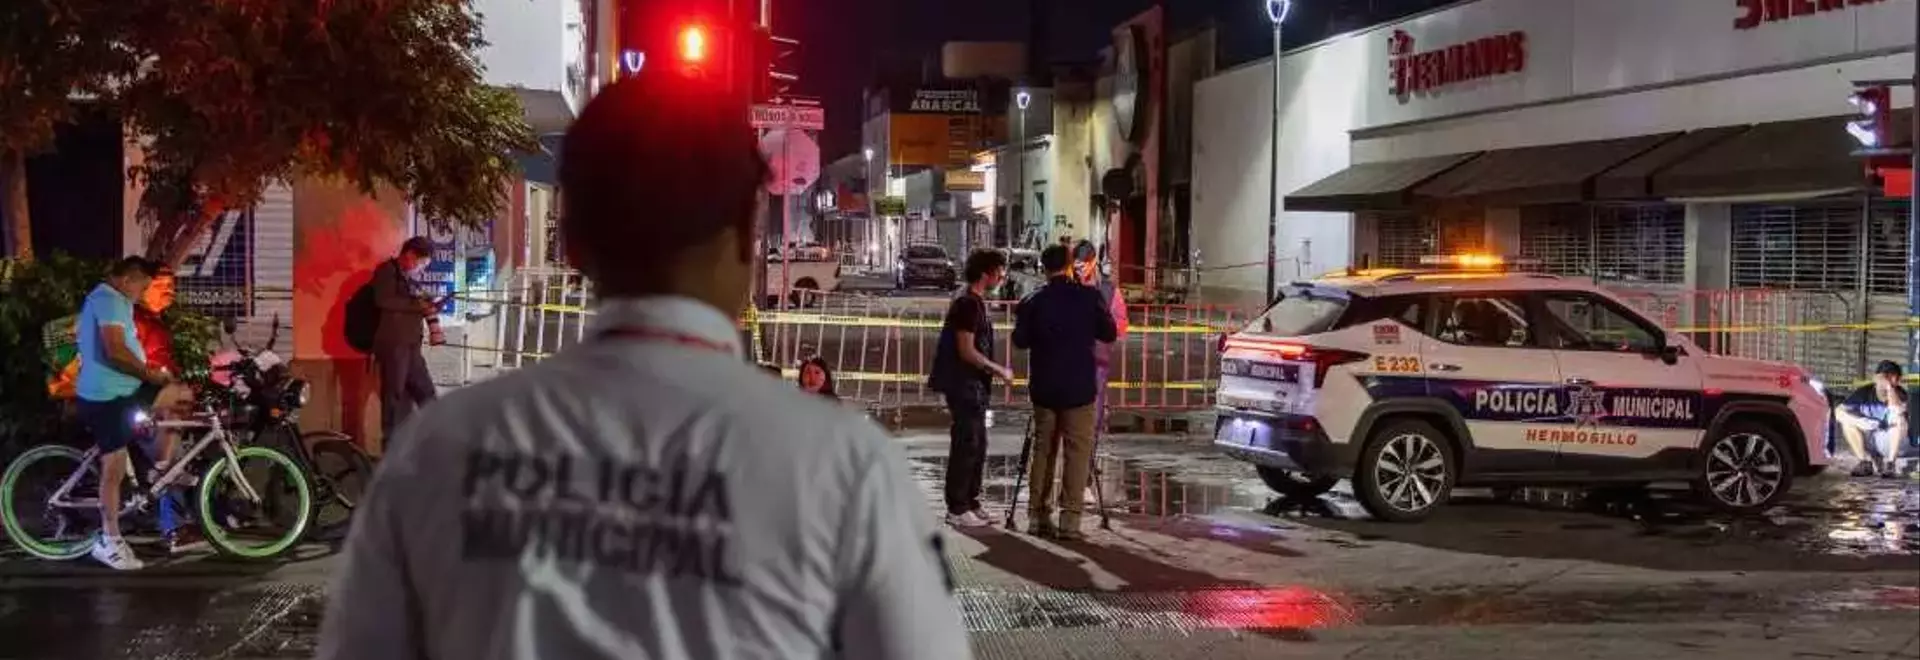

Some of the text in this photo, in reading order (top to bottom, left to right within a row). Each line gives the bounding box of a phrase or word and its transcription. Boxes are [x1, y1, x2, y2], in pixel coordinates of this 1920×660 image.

[1408, 30, 1525, 92] HERMANOS
[1375, 356, 1419, 372] E 232
[1475, 388, 1694, 420] POLICÍA MUNICIPAL
[1526, 428, 1637, 446] HERMOSILLO
